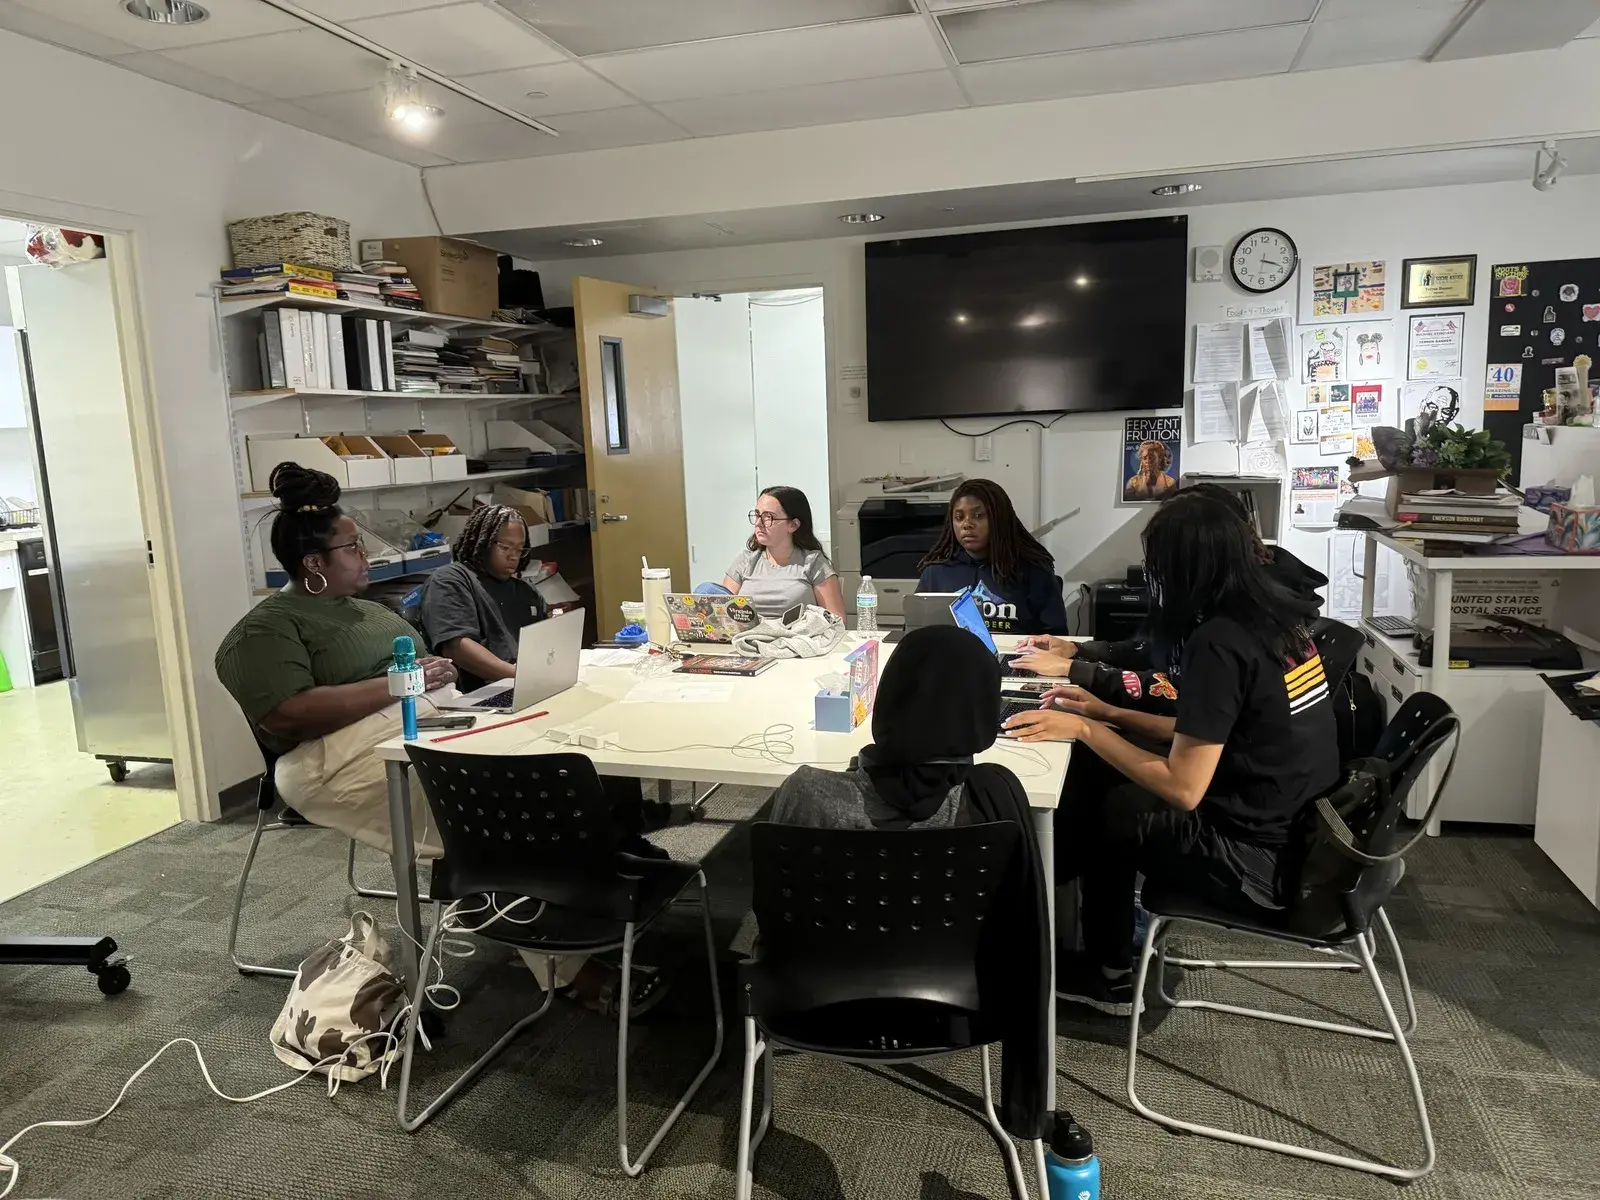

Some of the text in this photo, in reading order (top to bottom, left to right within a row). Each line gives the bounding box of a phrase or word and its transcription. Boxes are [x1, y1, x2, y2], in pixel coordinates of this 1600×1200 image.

[1250, 239, 1257, 247] 11
[1238, 257, 1245, 265] 9
[1240, 267, 1248, 275] 8
[1277, 266, 1284, 274] 4
[1258, 277, 1265, 285] 6
[1269, 274, 1276, 282] 5
[1492, 367, 1514, 382] 40
[1126, 418, 1180, 430] FERVENT
[1126, 429, 1180, 441] FRUITION
[1451, 595, 1540, 604] UNITED STATES
[729, 607, 753, 615] Virginia
[983, 601, 1019, 620] on
[1493, 606, 1543, 615] SERVICE
[984, 620, 1011, 629] BEER
